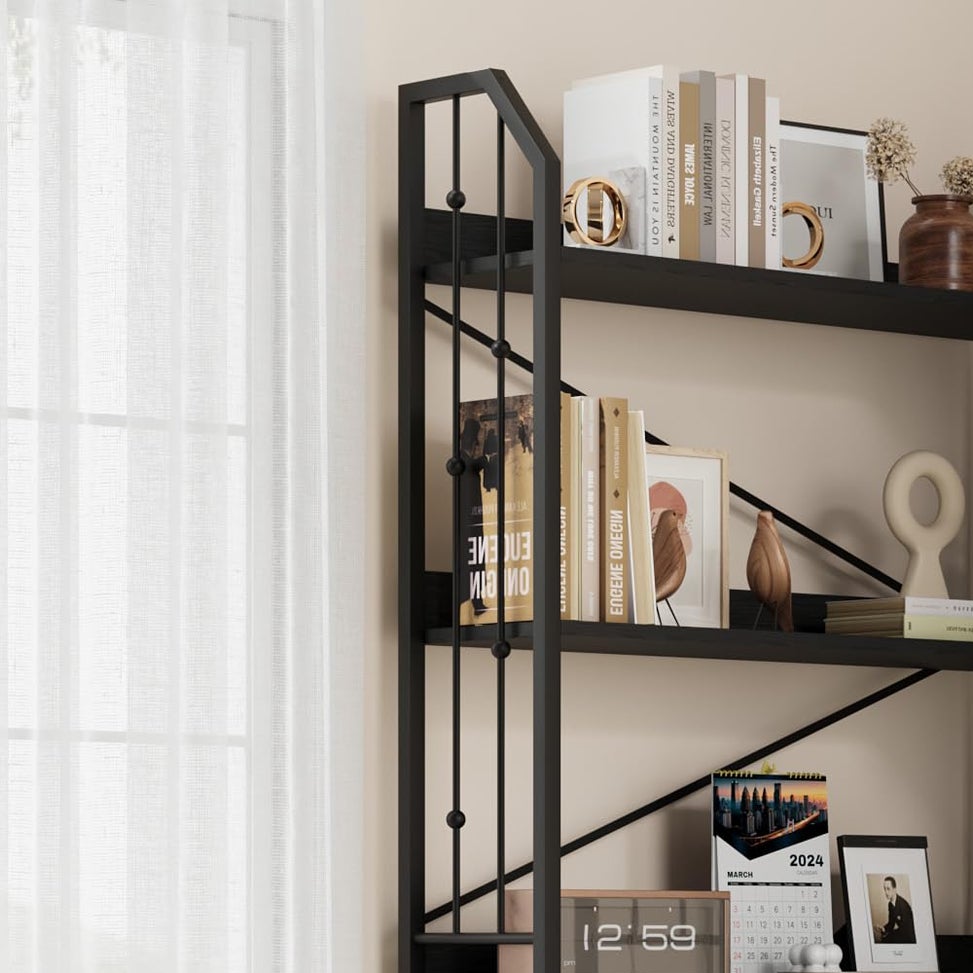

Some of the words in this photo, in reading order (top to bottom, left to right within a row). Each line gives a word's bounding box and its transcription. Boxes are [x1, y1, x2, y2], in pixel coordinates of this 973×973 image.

[789, 854, 824, 867] 2024
[733, 952, 741, 960] 24
[747, 952, 755, 960] 25
[760, 952, 769, 960] 26
[774, 952, 782, 960] 27
